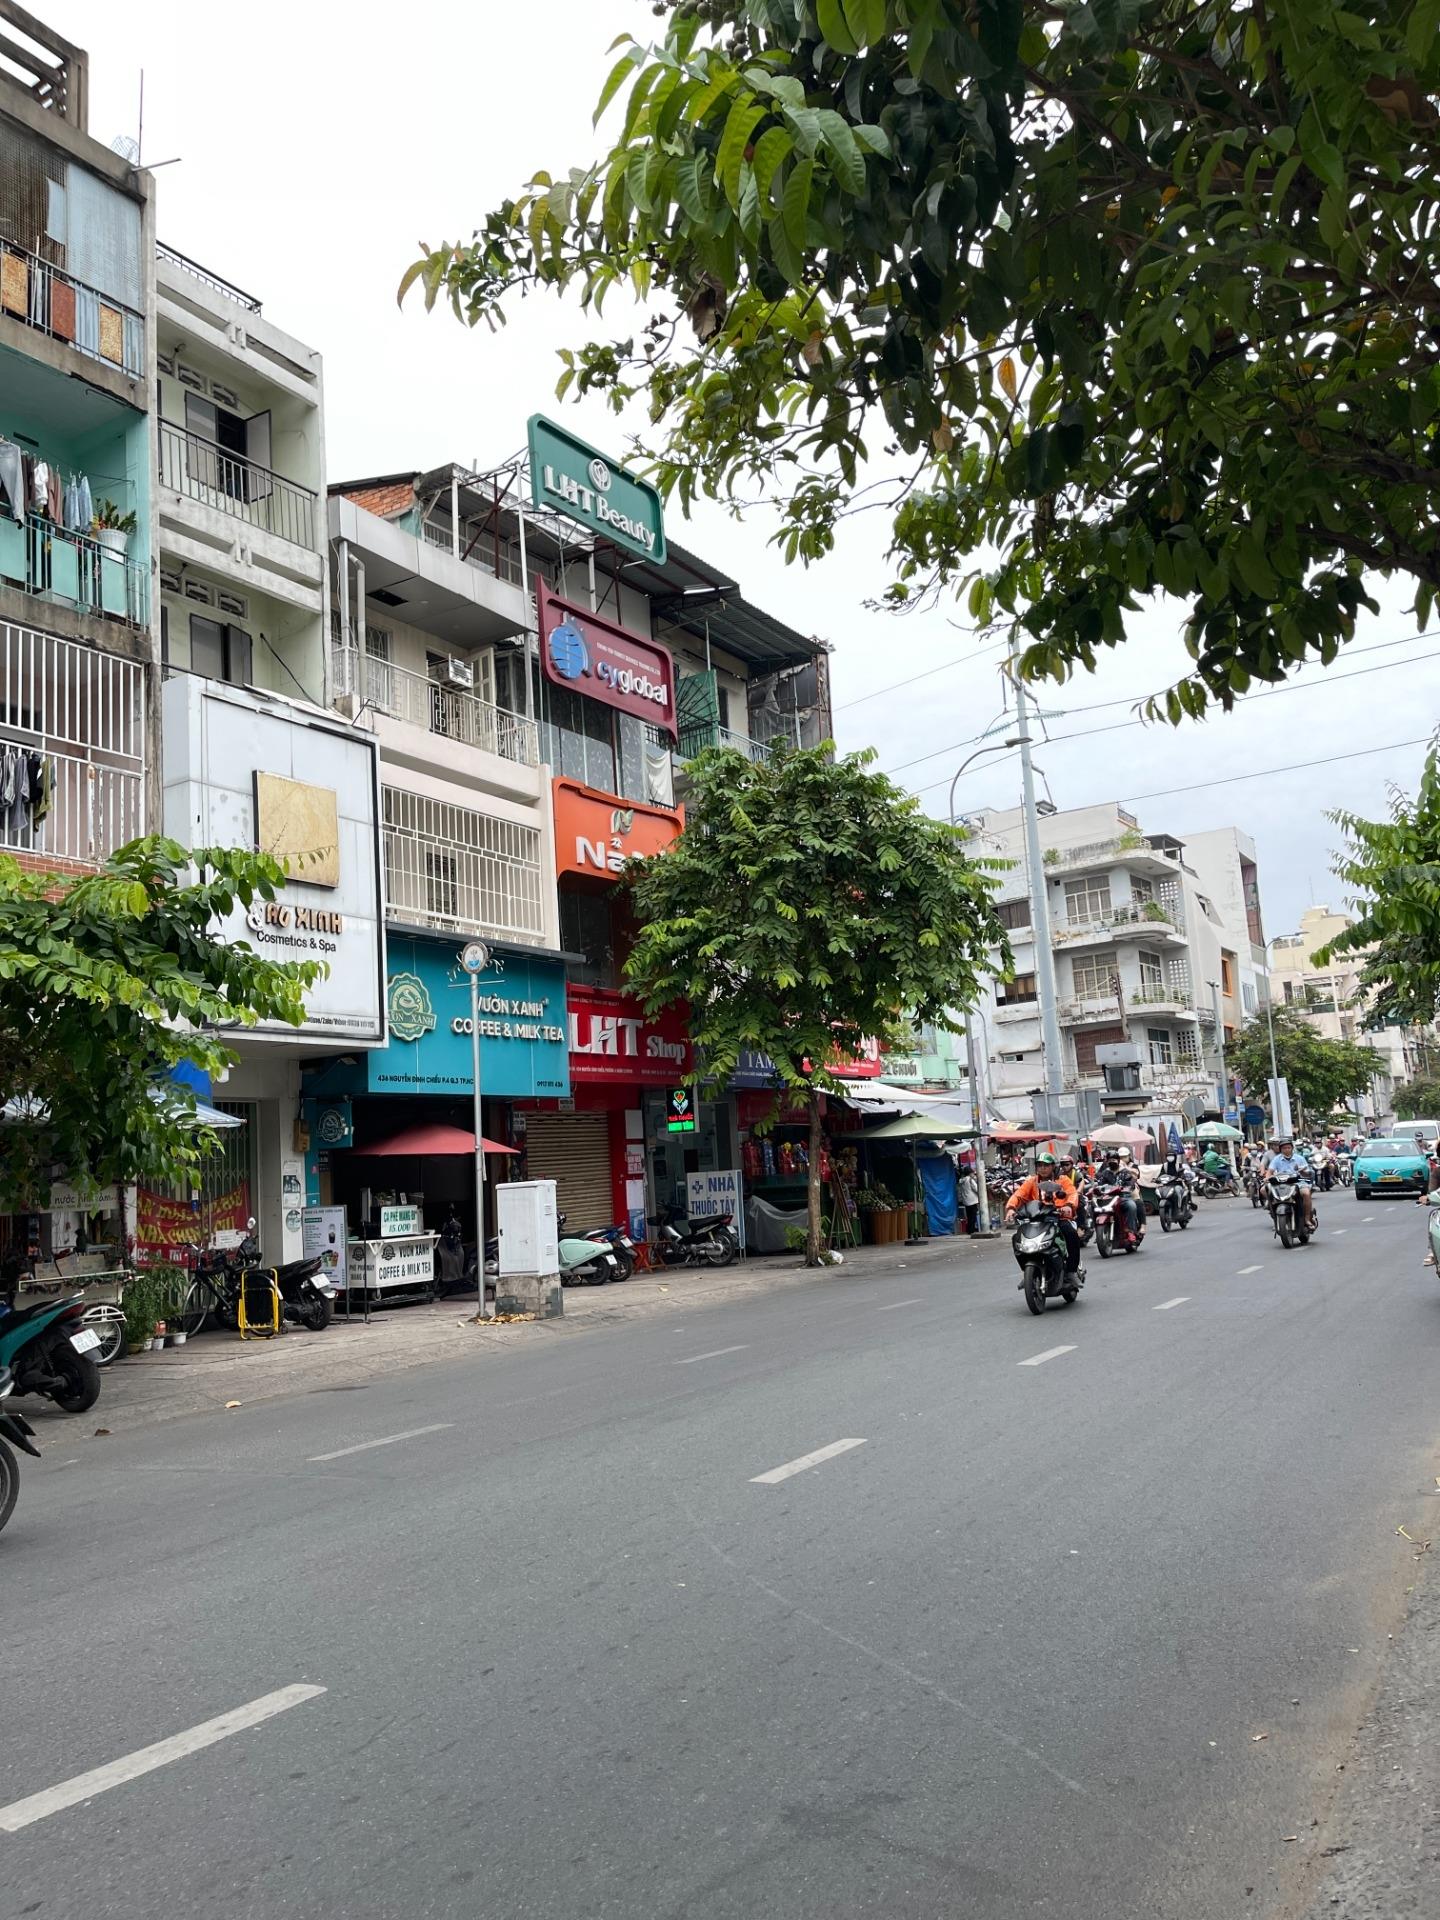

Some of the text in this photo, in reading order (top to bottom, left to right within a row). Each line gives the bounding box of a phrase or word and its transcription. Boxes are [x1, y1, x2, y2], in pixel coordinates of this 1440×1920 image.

[596, 494, 656, 551] Beauty
[597, 661, 669, 706] cyglobal
[257, 930, 336, 954] Cosmetics & Spa
[512, 1000, 544, 1017] XANH
[452, 1017, 564, 1041] COFEE & MILK TEA
[567, 1012, 686, 1065] LHT Shop
[709, 1173, 735, 1192] NHÀ
[691, 1194, 735, 1215] THUỐC TÂY
[379, 1265, 400, 1280] COFFEE
[407, 1263, 420, 1276] MILK
[422, 1261, 431, 1274] TEA
